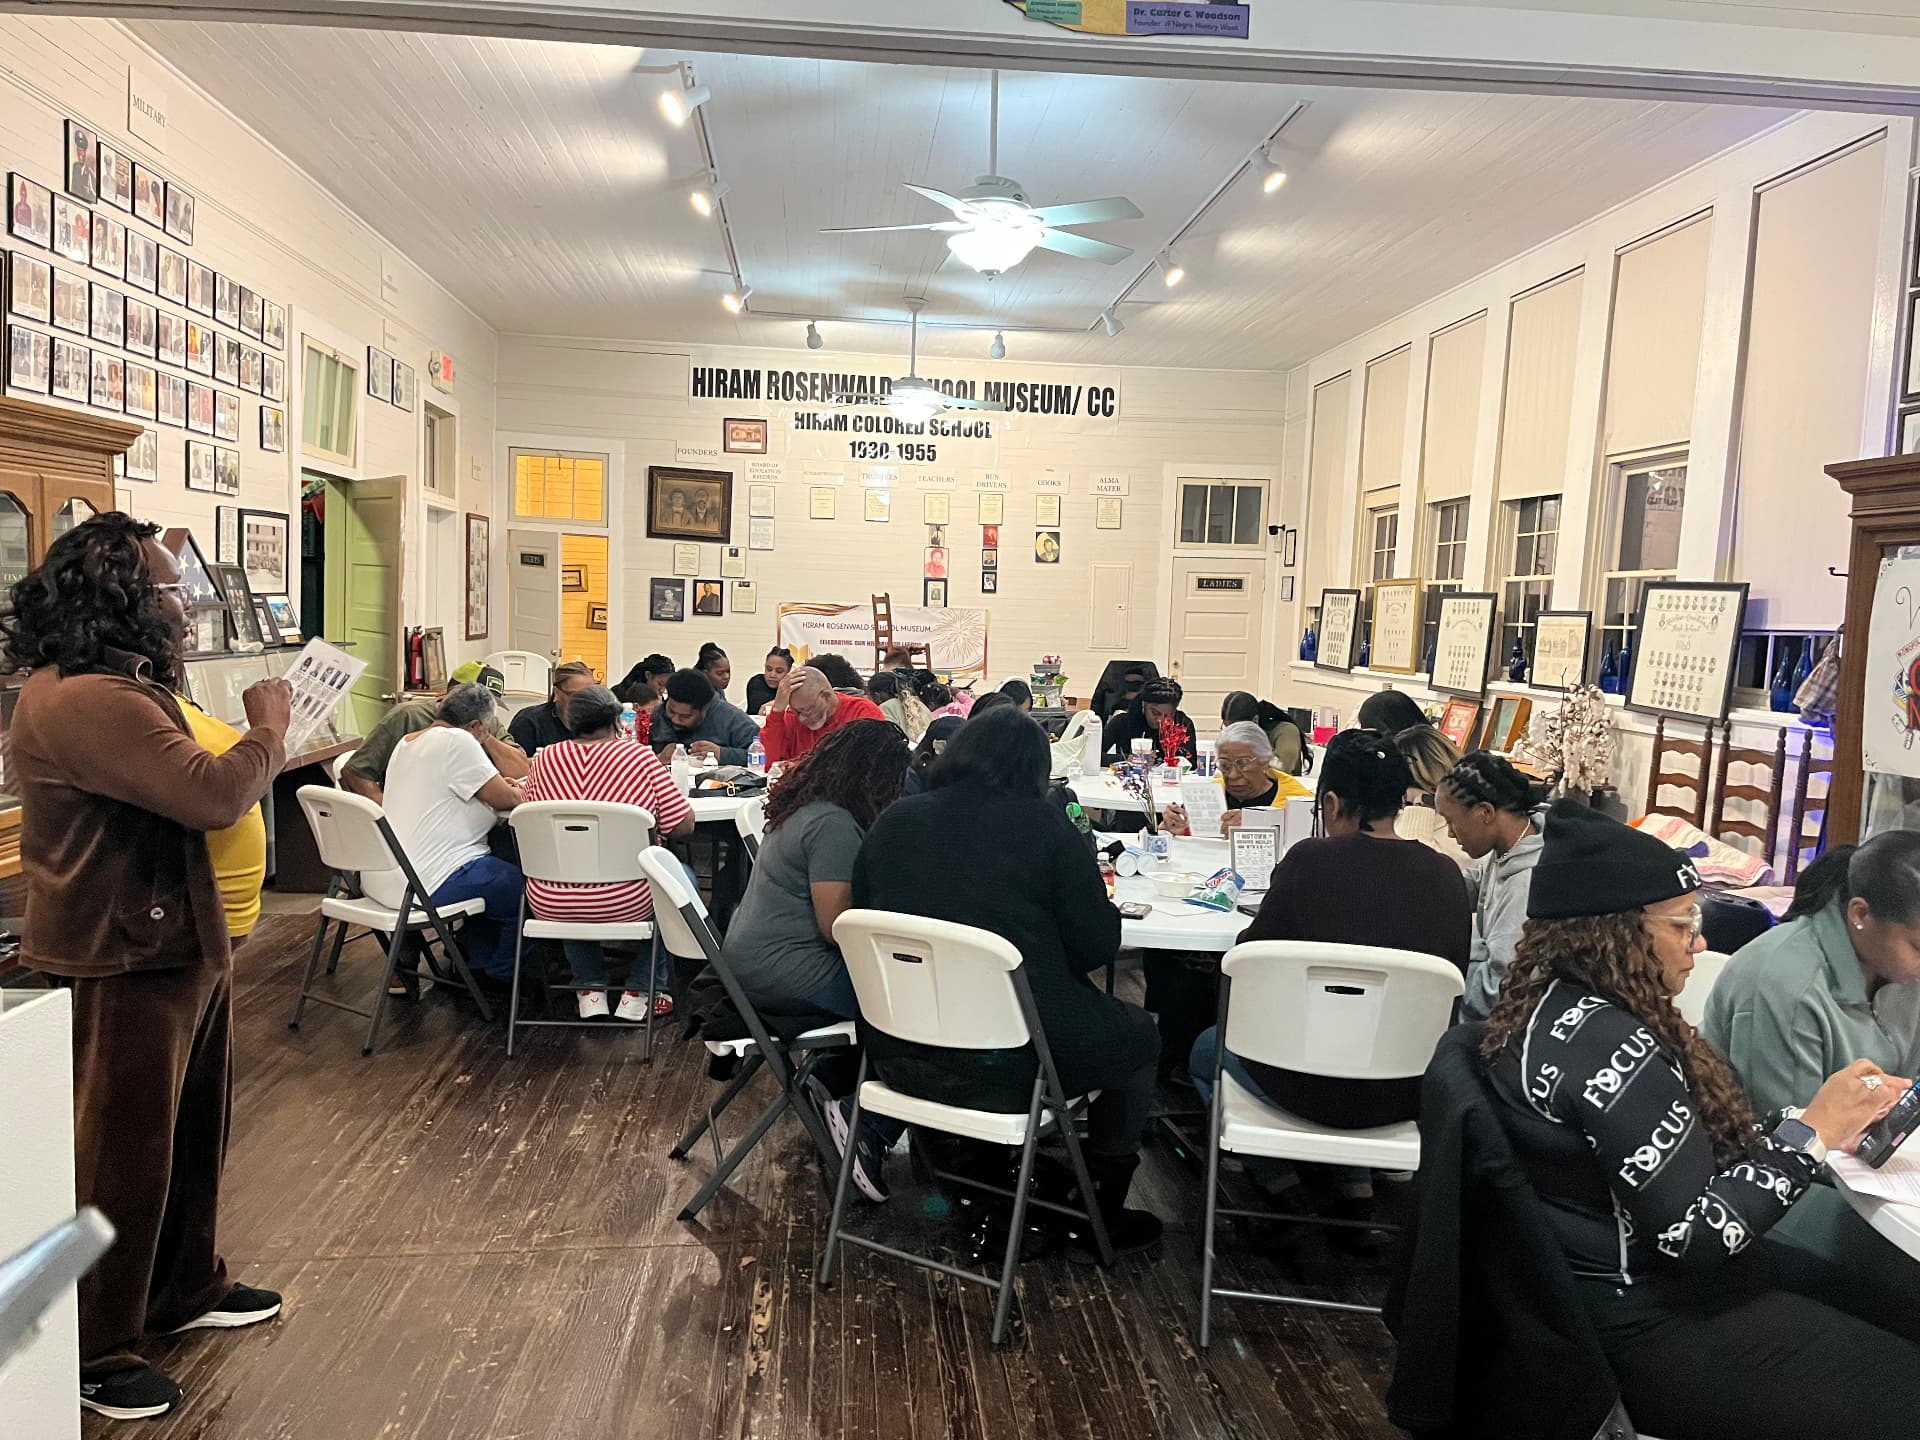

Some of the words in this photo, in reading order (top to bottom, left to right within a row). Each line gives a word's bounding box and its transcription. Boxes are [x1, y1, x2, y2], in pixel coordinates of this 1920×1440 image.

[1133, 8, 1146, 16] Dr.
[1150, 9, 1181, 18] Carter
[1184, 10, 1192, 18] G.
[1195, 11, 1240, 20] Woodson
[132, 94, 166, 128] MILITARY
[692, 367, 761, 399] HIRAM
[767, 370, 893, 406] ROSENWALD
[984, 381, 1083, 415] MUSEUM/
[1087, 387, 1115, 417] CC
[794, 412, 848, 432] HIRAM
[929, 418, 992, 439] SCHOOL
[677, 447, 718, 457] FOUNDERS
[918, 475, 955, 483] TEACHERS
[976, 481, 1007, 489] DRIVERS
[1037, 479, 1062, 487] COOKS
[1203, 579, 1237, 588] LADIES
[802, 621, 825, 629] HIRAM
[826, 622, 870, 631] ROSENWALD
[870, 623, 899, 632] SHOOL
[900, 624, 931, 633] MUSEUM
[1582, 1027, 1655, 1109] FOCUS
[1618, 1100, 1691, 1187] FOCUS
